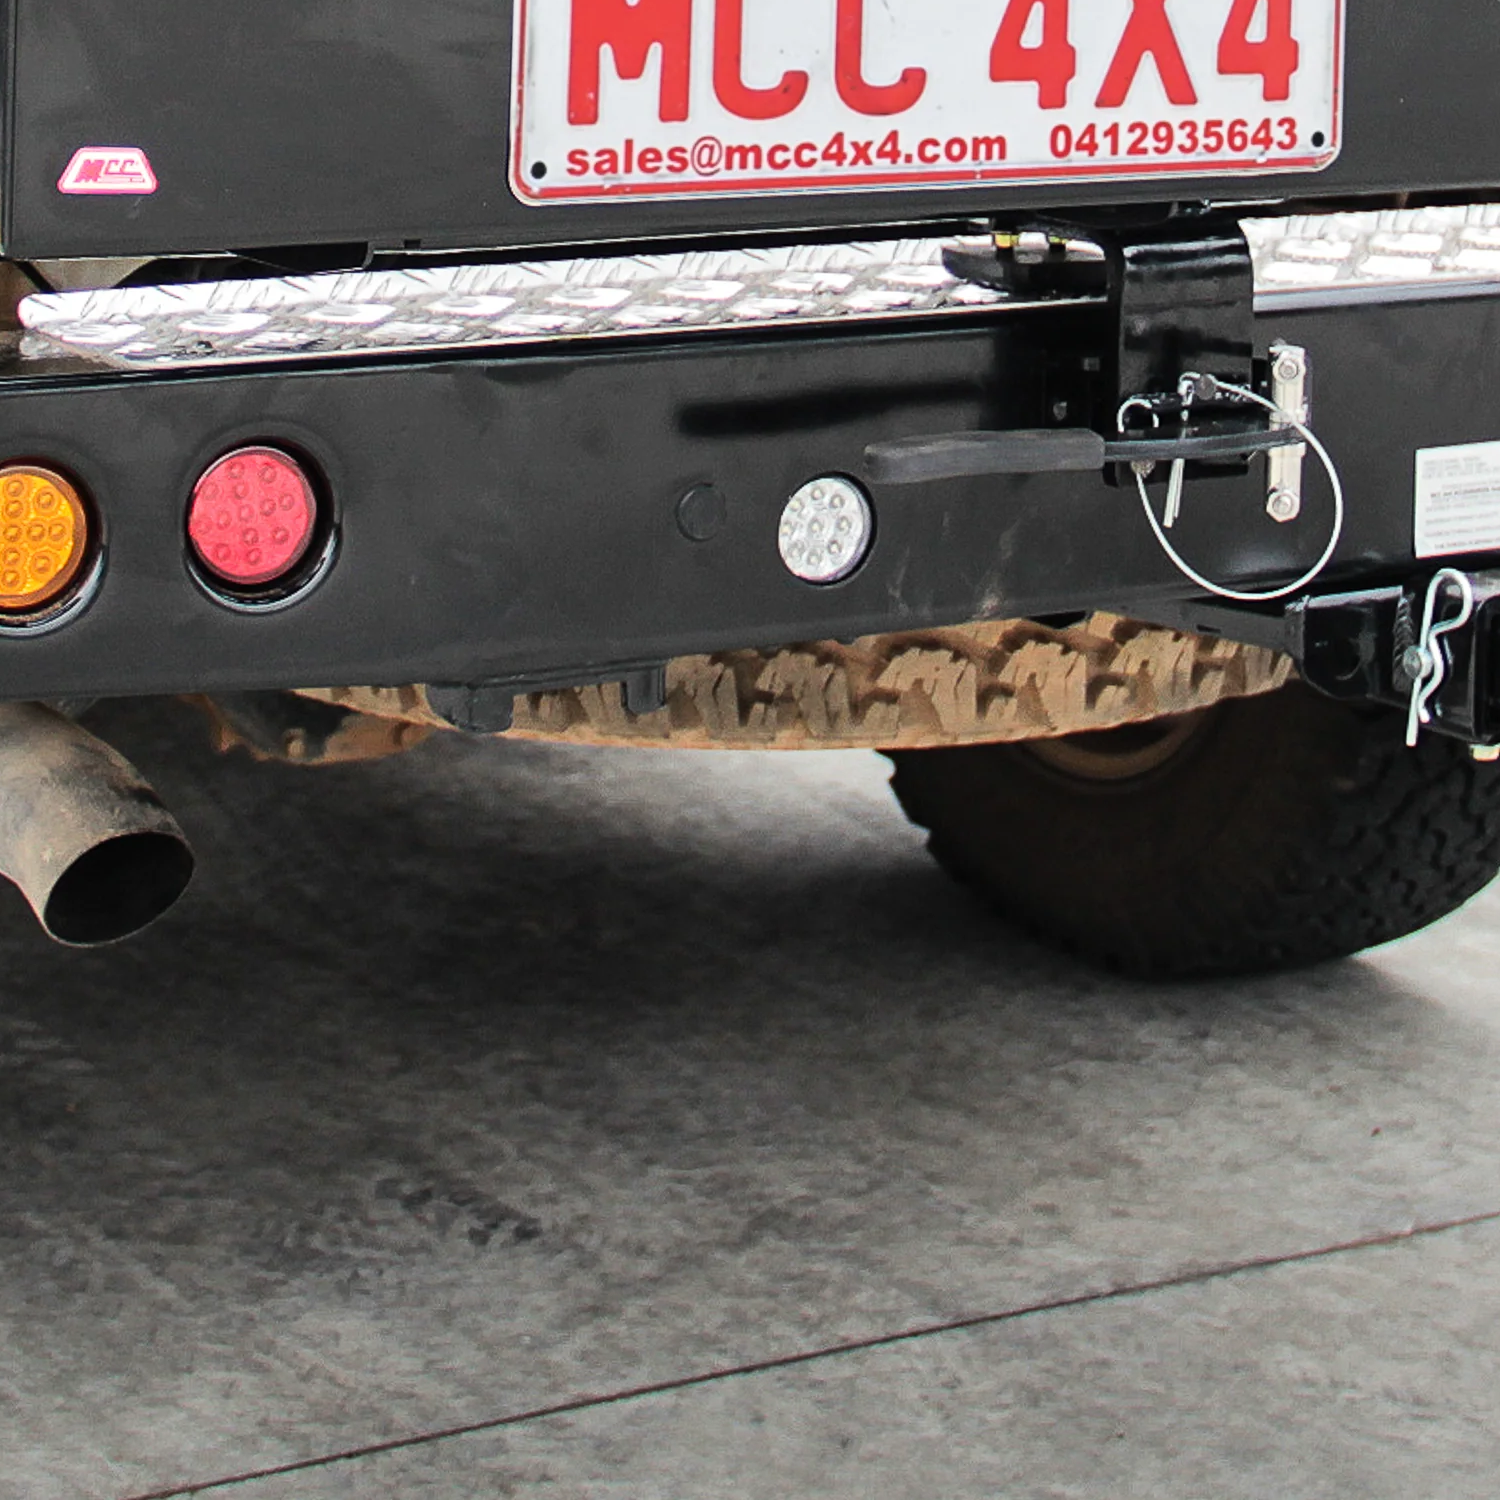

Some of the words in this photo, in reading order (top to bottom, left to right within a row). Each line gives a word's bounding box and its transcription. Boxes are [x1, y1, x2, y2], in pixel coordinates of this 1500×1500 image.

[567, 129, 1007, 177] sales@mcc4x4.com
[1049, 117, 1299, 160] 0412935643
[73, 158, 145, 184] MCC
